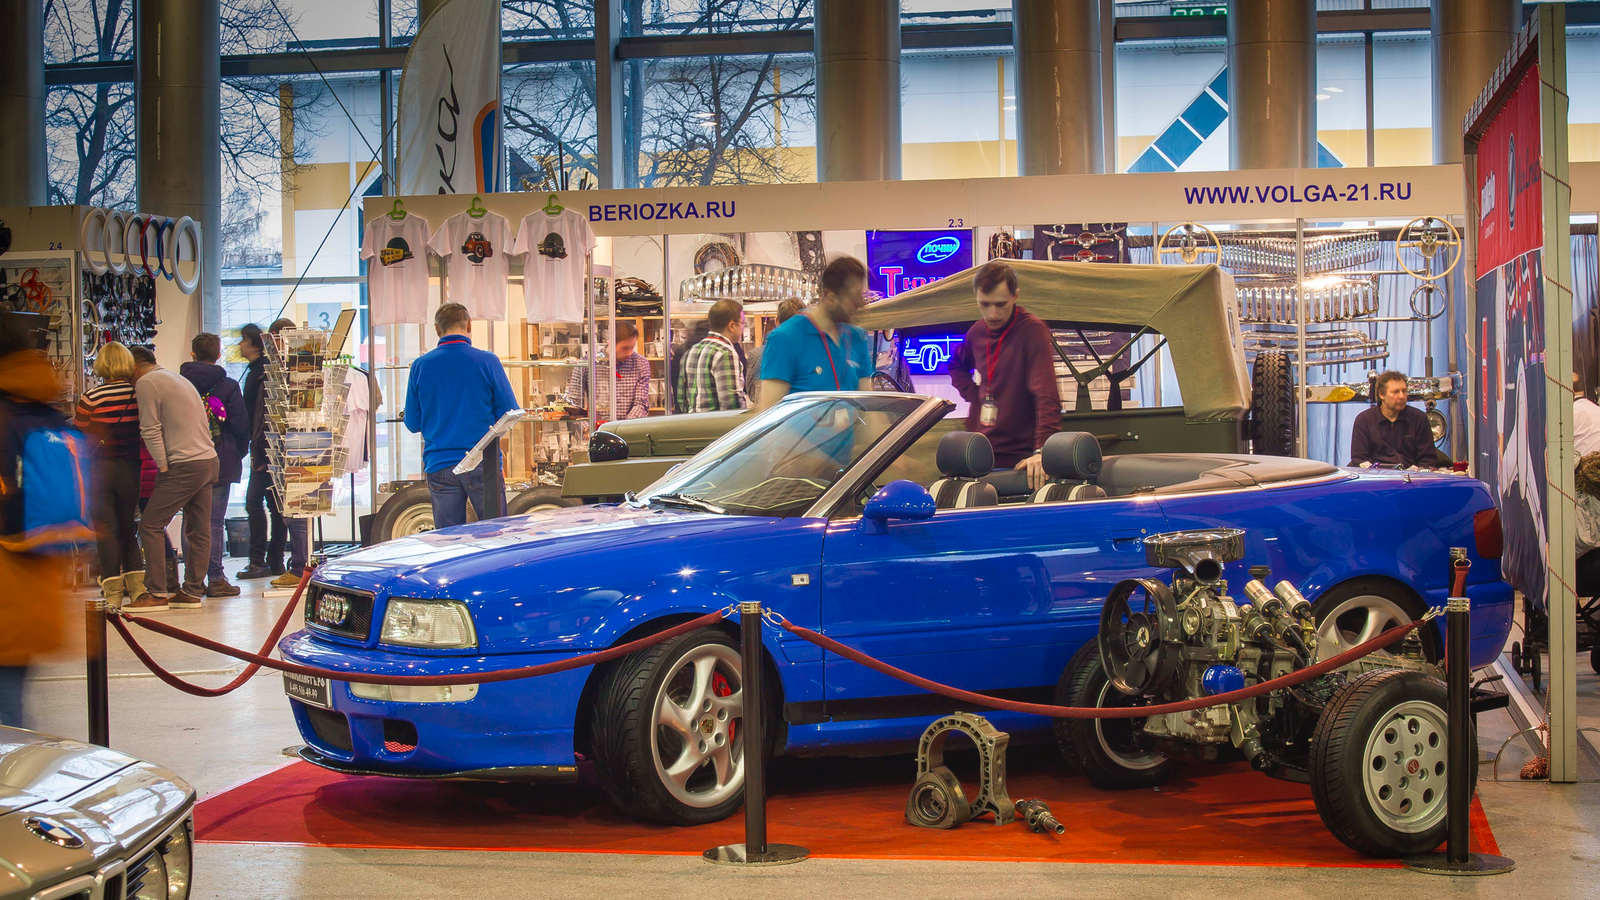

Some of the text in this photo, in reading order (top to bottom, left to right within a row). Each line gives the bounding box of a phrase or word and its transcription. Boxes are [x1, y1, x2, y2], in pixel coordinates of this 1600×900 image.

[1184, 182, 1412, 205] WWW.VOLGA-21.RU
[589, 201, 736, 222] BERIOZKA.RU
[948, 218, 964, 228] 2.3
[49, 242, 62, 251] 2.4
[318, 311, 331, 330] 3
